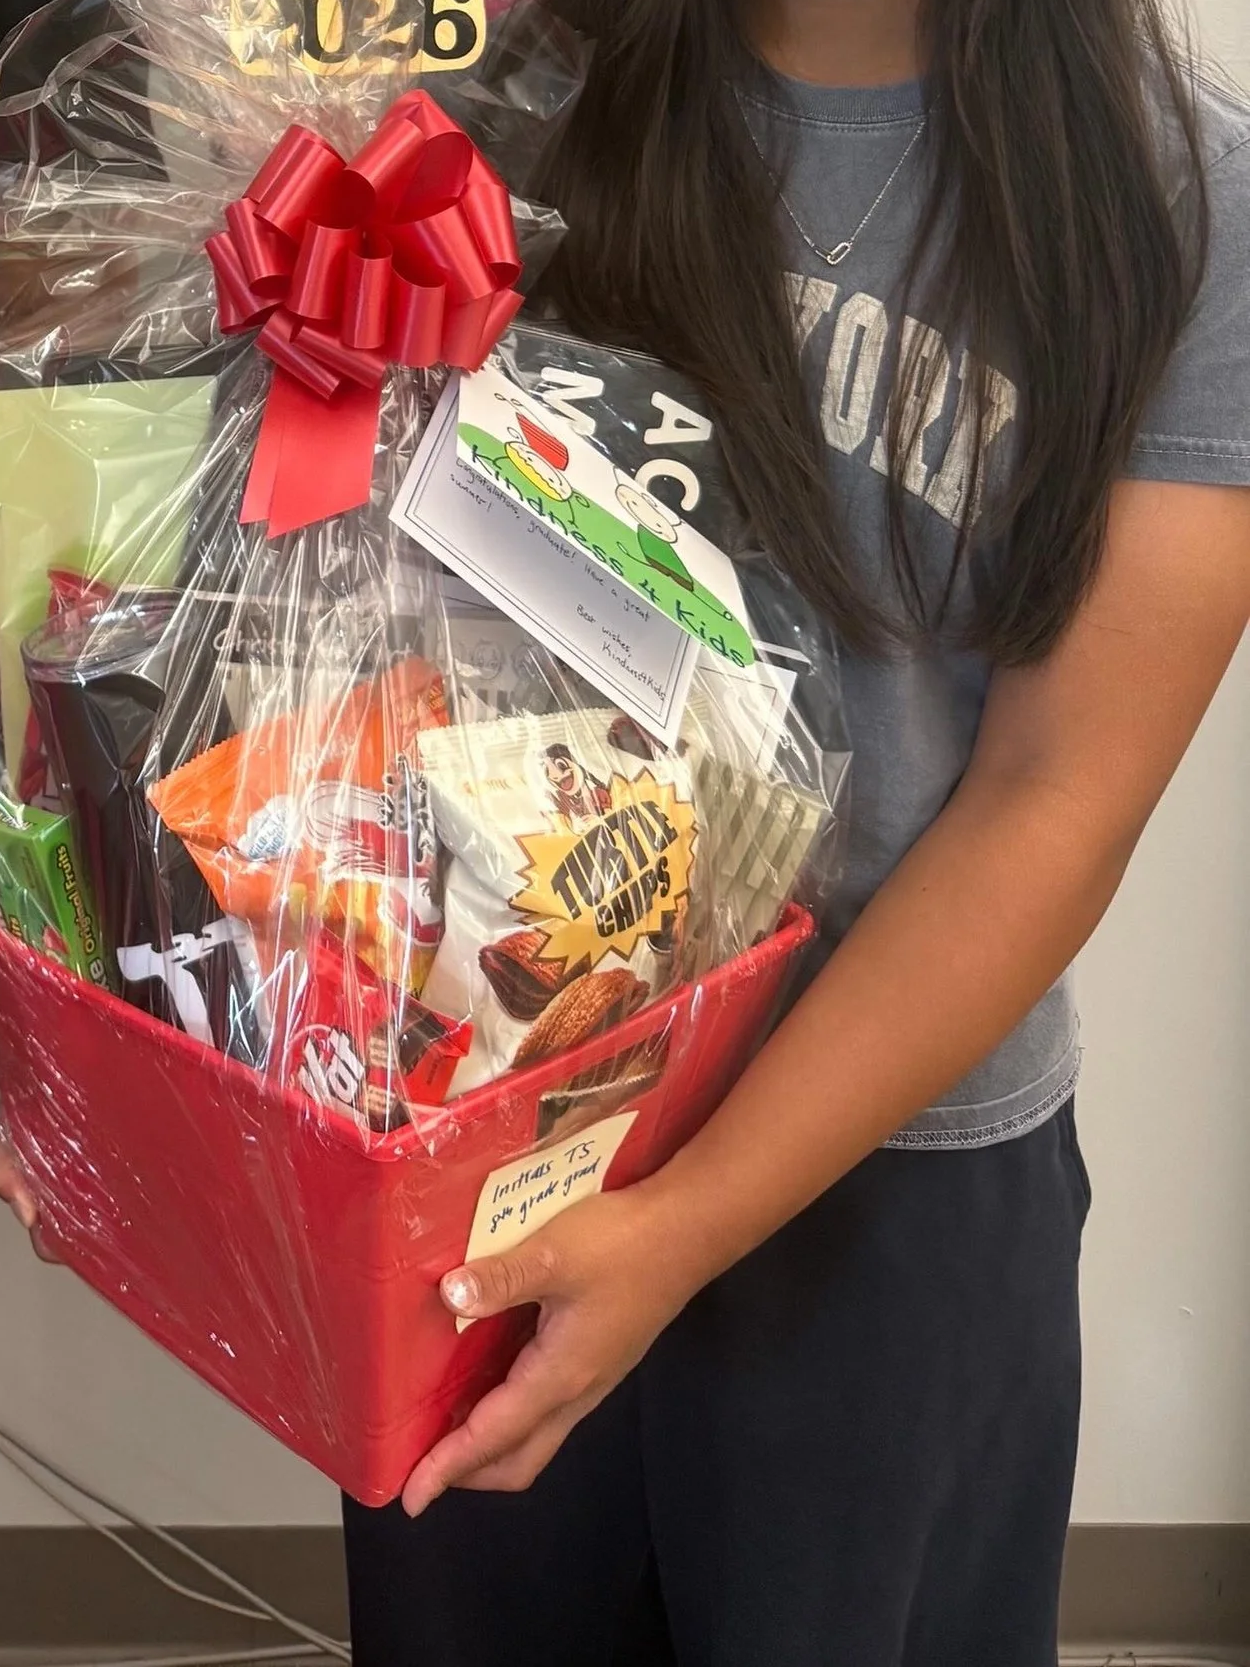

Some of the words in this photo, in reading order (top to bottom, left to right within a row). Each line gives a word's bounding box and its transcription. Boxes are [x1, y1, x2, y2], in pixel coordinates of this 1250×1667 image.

[471, 444, 624, 577] Kindness
[634, 577, 661, 604] 4
[675, 598, 746, 669] Kids
[623, 598, 651, 623] great
[56, 843, 77, 891] Fruits
[550, 799, 679, 921] TURTLE
[595, 855, 671, 938] CHIPS
[67, 891, 97, 954] Original
